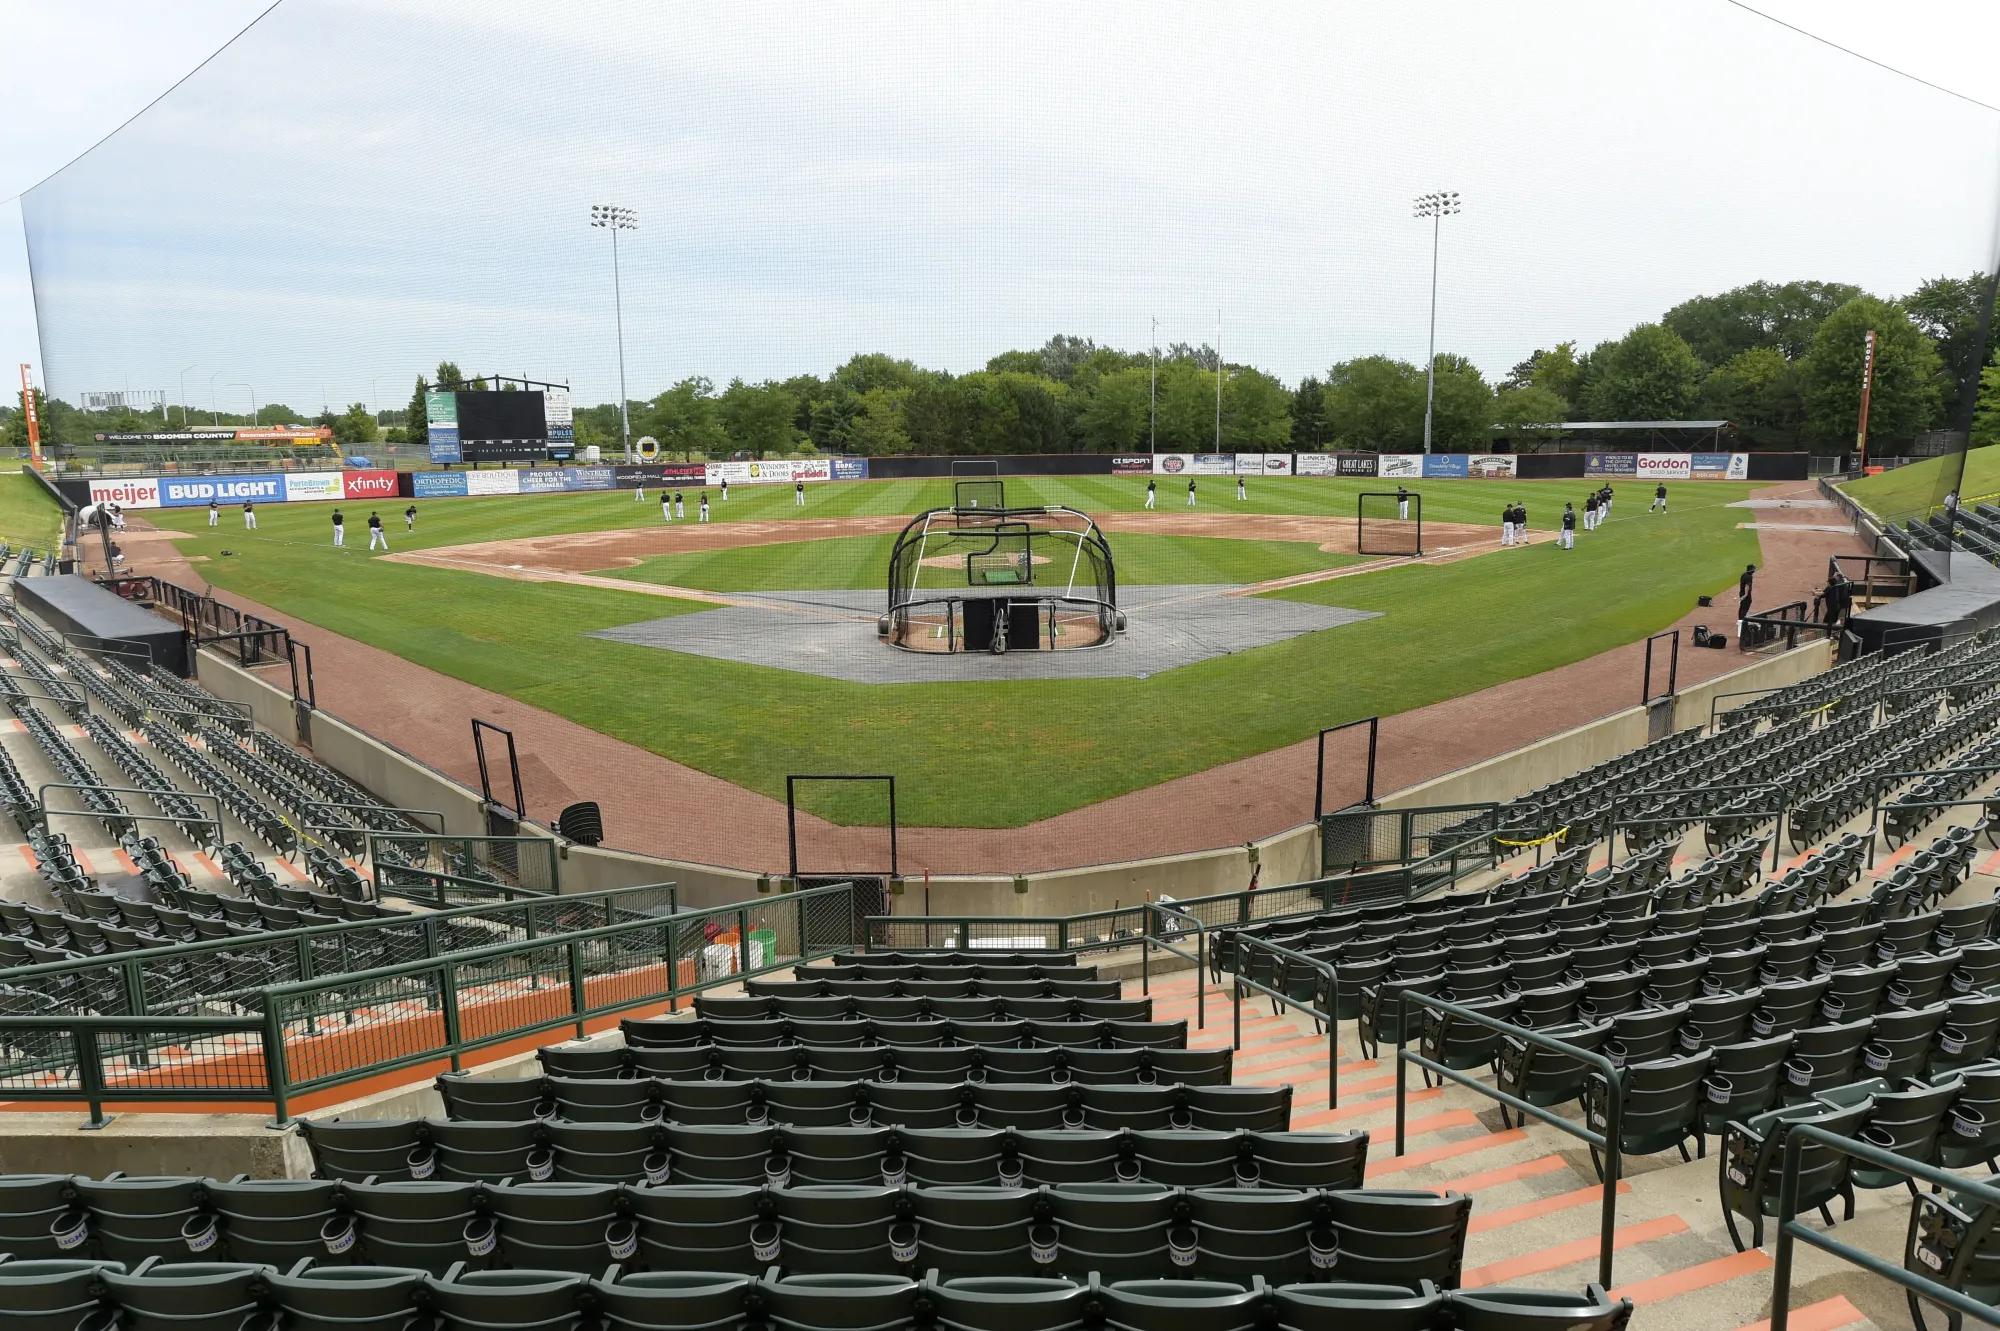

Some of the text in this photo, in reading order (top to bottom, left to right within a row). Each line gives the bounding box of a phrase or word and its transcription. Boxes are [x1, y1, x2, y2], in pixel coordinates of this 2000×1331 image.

[1861, 342, 1872, 389] HOOTERS
[1342, 459, 1373, 468] GREAT LAKES
[1638, 457, 1689, 469] Gordon
[769, 470, 789, 478] DOORS
[289, 479, 330, 487] PorteBrown
[348, 477, 394, 492] xfinity
[414, 477, 466, 485] ORTHOPEDICS
[92, 483, 157, 504] meijer
[168, 481, 277, 499] BUD LIGHT
[1943, 1041, 1959, 1052] BUD
[1867, 1056, 1882, 1067] BUD
[1789, 1072, 1805, 1083] BUD
[1708, 1090, 1726, 1100] BUD
[1955, 1122, 1976, 1134] BUD
[1732, 1170, 1744, 1182] 12
[1925, 1252, 1938, 1266] 13
